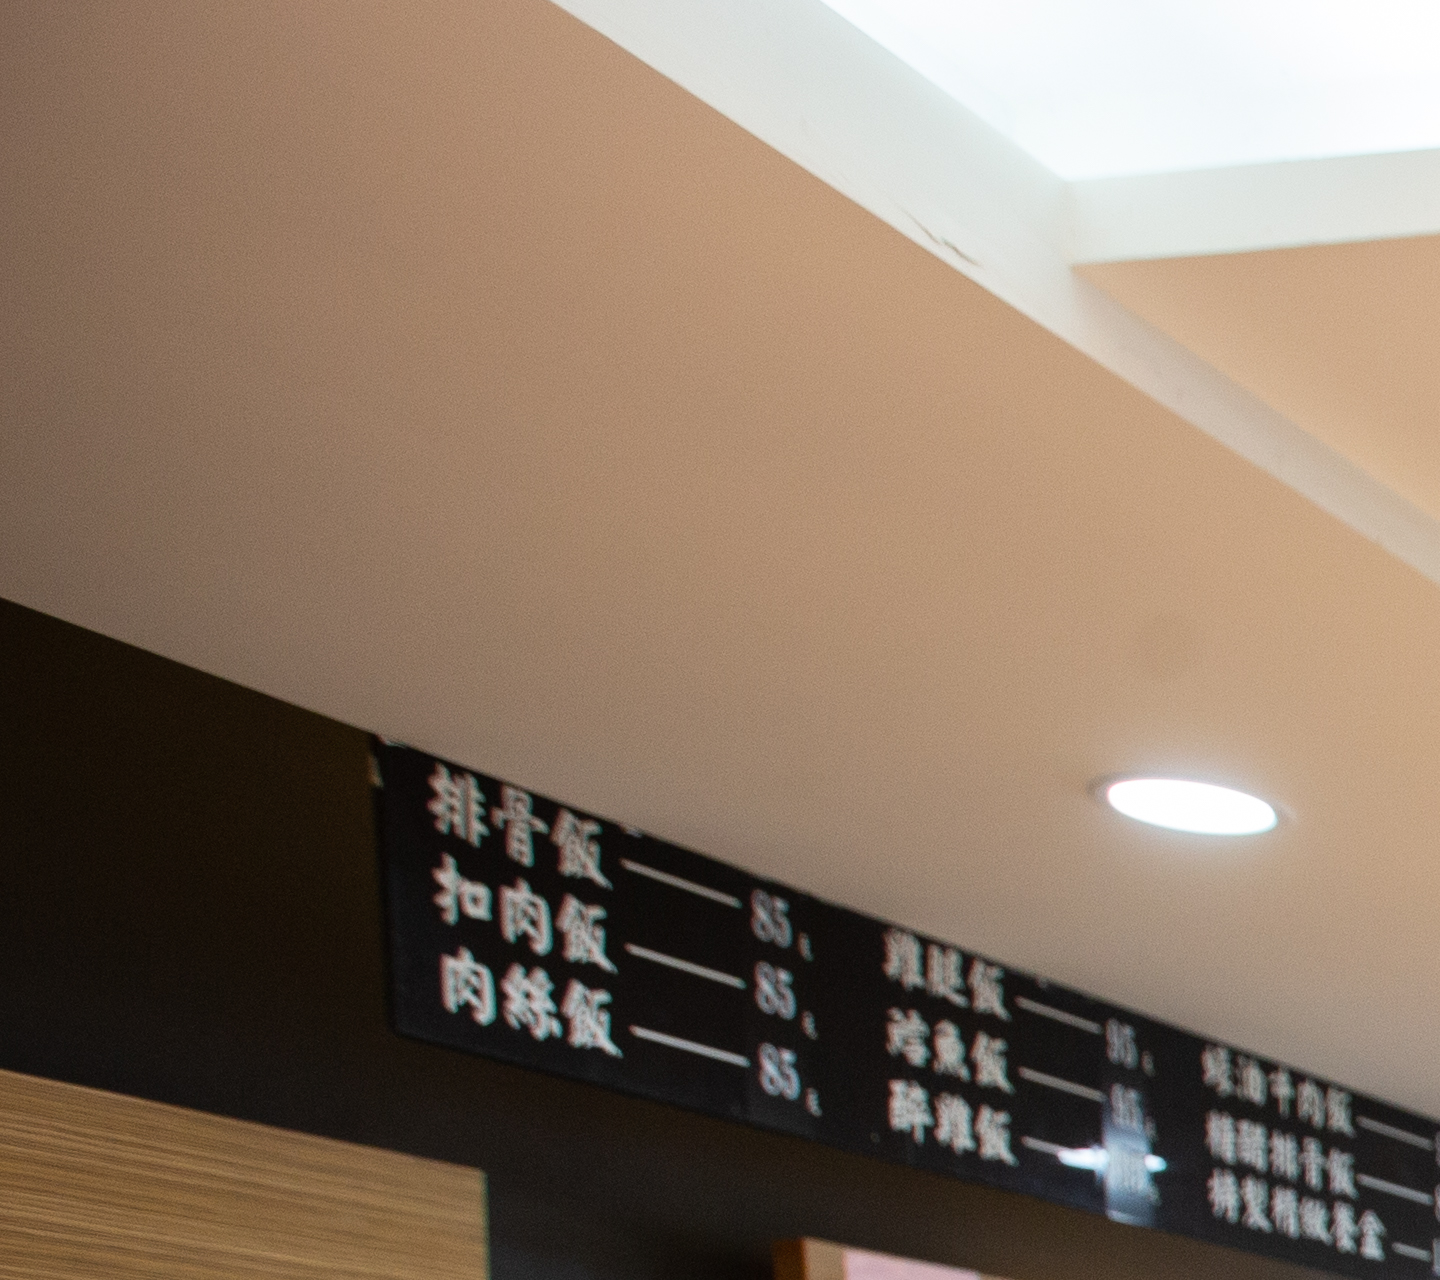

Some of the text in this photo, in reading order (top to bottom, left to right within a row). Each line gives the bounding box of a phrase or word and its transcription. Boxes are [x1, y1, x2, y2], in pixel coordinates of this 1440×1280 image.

[426, 762, 613, 892] 排骨飯
[431, 852, 618, 975] 扣肉飯
[439, 946, 624, 1059] 肉絲飯
[882, 927, 1012, 1022] 雞腿飯
